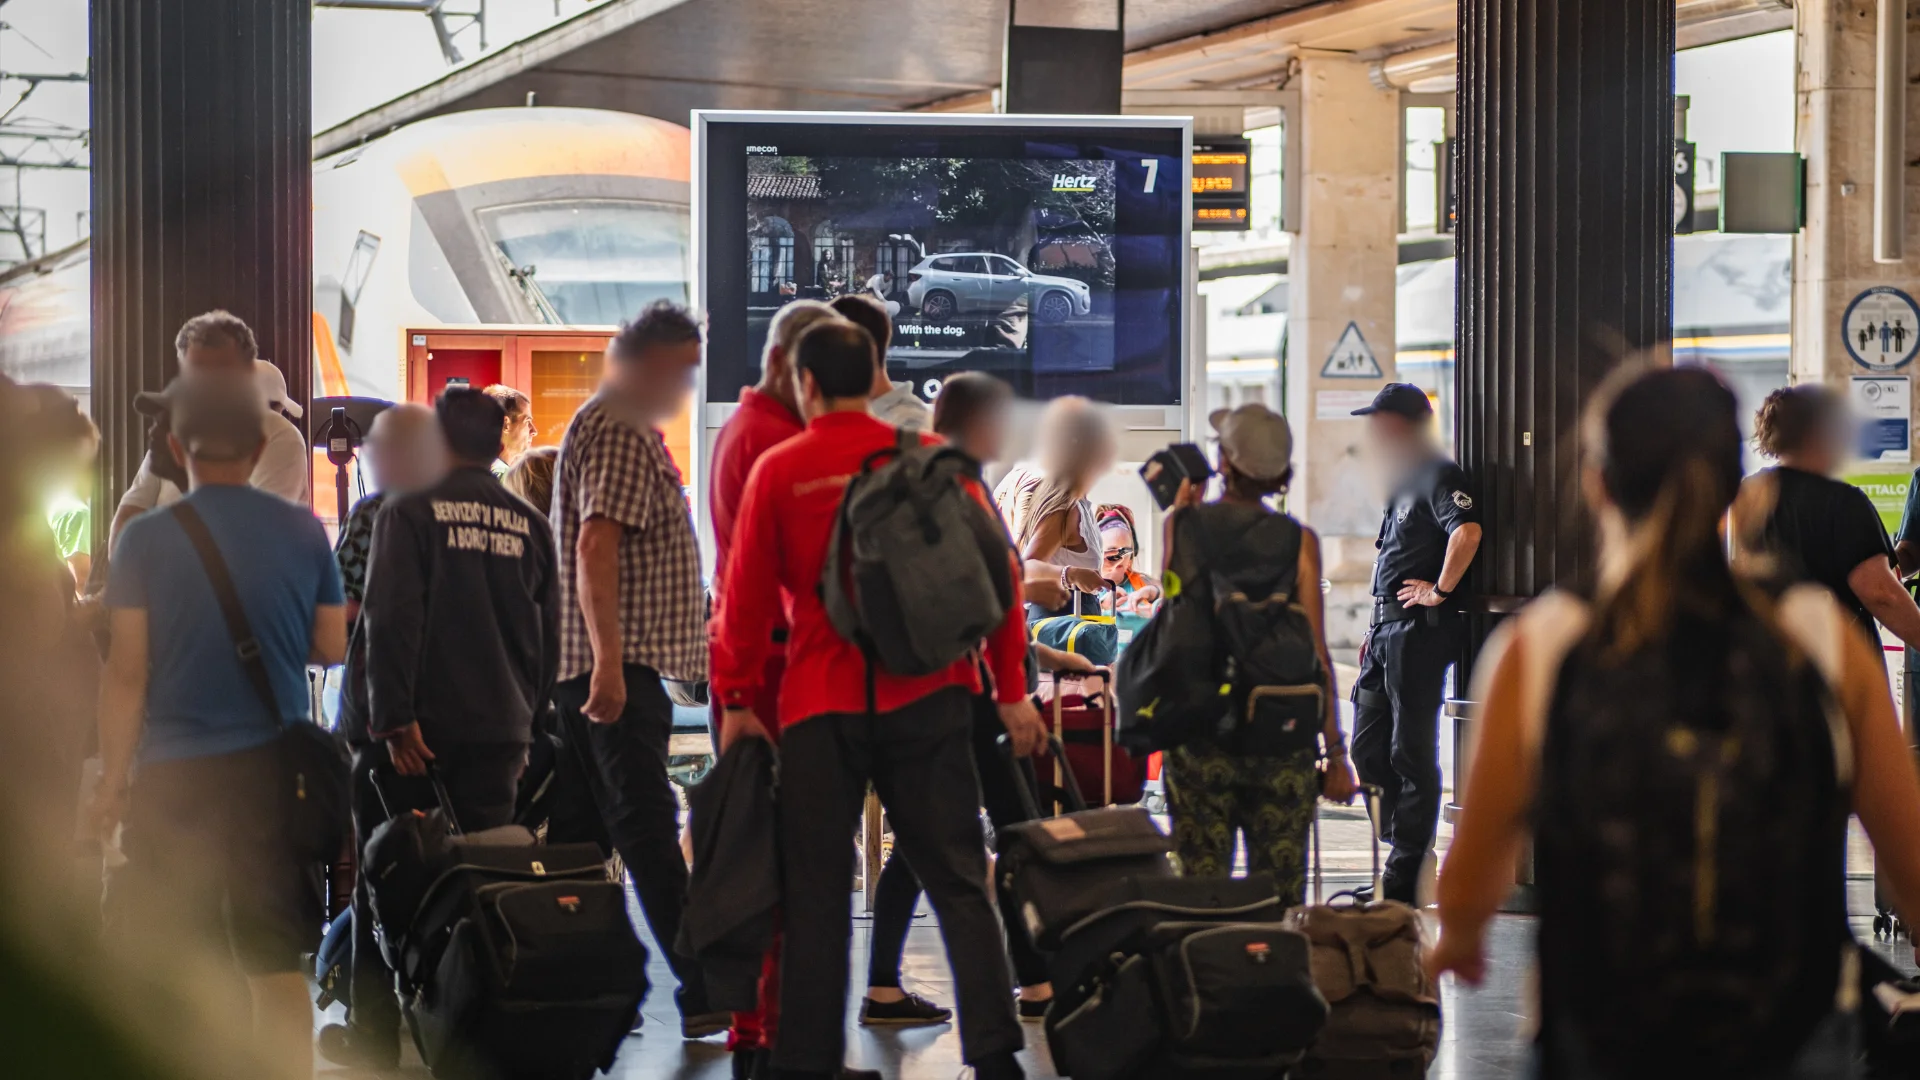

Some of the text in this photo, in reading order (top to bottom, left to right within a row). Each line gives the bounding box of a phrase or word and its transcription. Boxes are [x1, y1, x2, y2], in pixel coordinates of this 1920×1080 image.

[1675, 151, 1689, 175] 6
[1052, 173, 1097, 188] Hertz
[1141, 158, 1159, 193] 7
[898, 324, 966, 337] With the dog.
[447, 526, 457, 549] A
